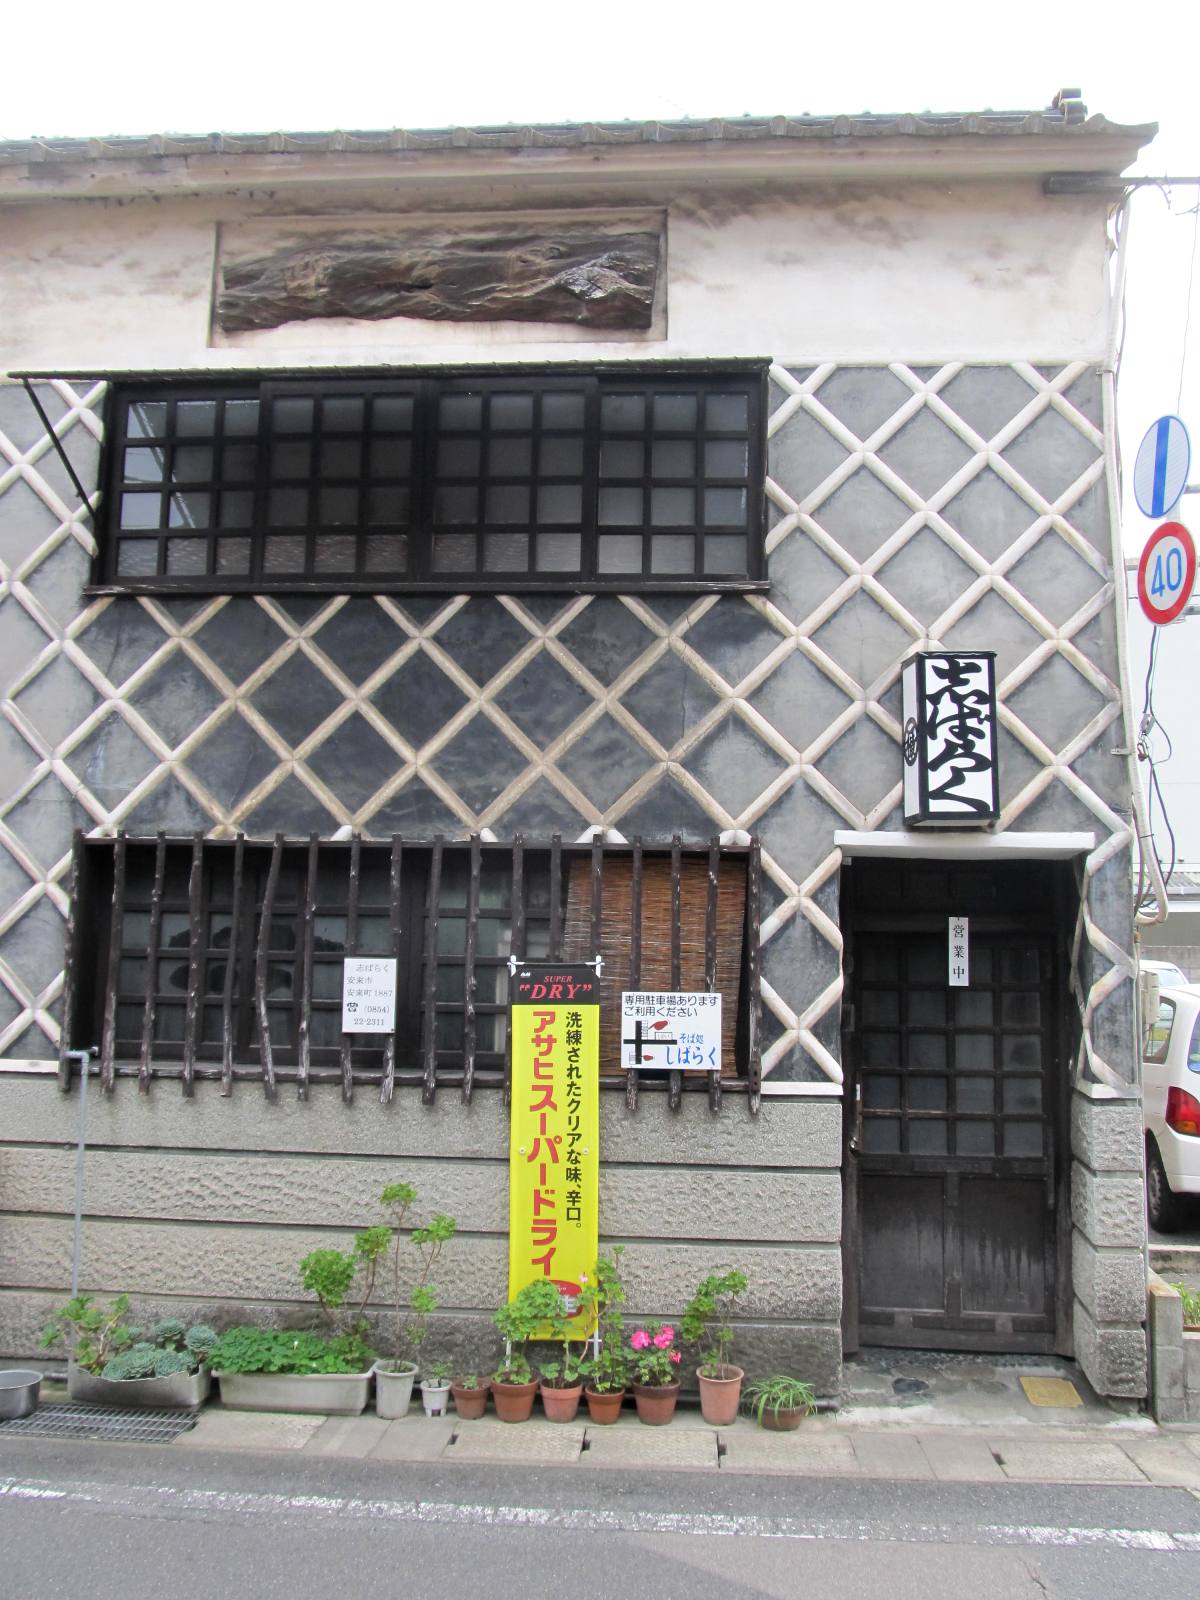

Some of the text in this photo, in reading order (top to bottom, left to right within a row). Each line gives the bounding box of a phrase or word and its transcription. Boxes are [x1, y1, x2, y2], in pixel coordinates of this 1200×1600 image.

[1151, 547, 1182, 597] 40
[953, 924, 965, 979] 営業中
[346, 975, 373, 985] 安来市
[544, 975, 573, 983] SUPER
[624, 994, 719, 1007] 専用駐車場あります
[624, 1006, 698, 1017] ご利用ください
[679, 1033, 704, 1045] そば処
[666, 1045, 716, 1066] しばらく
[566, 1011, 582, 1229] 洗練されたクリアな味、辛口。
[527, 1011, 562, 1276] アサヒスーパードライ
